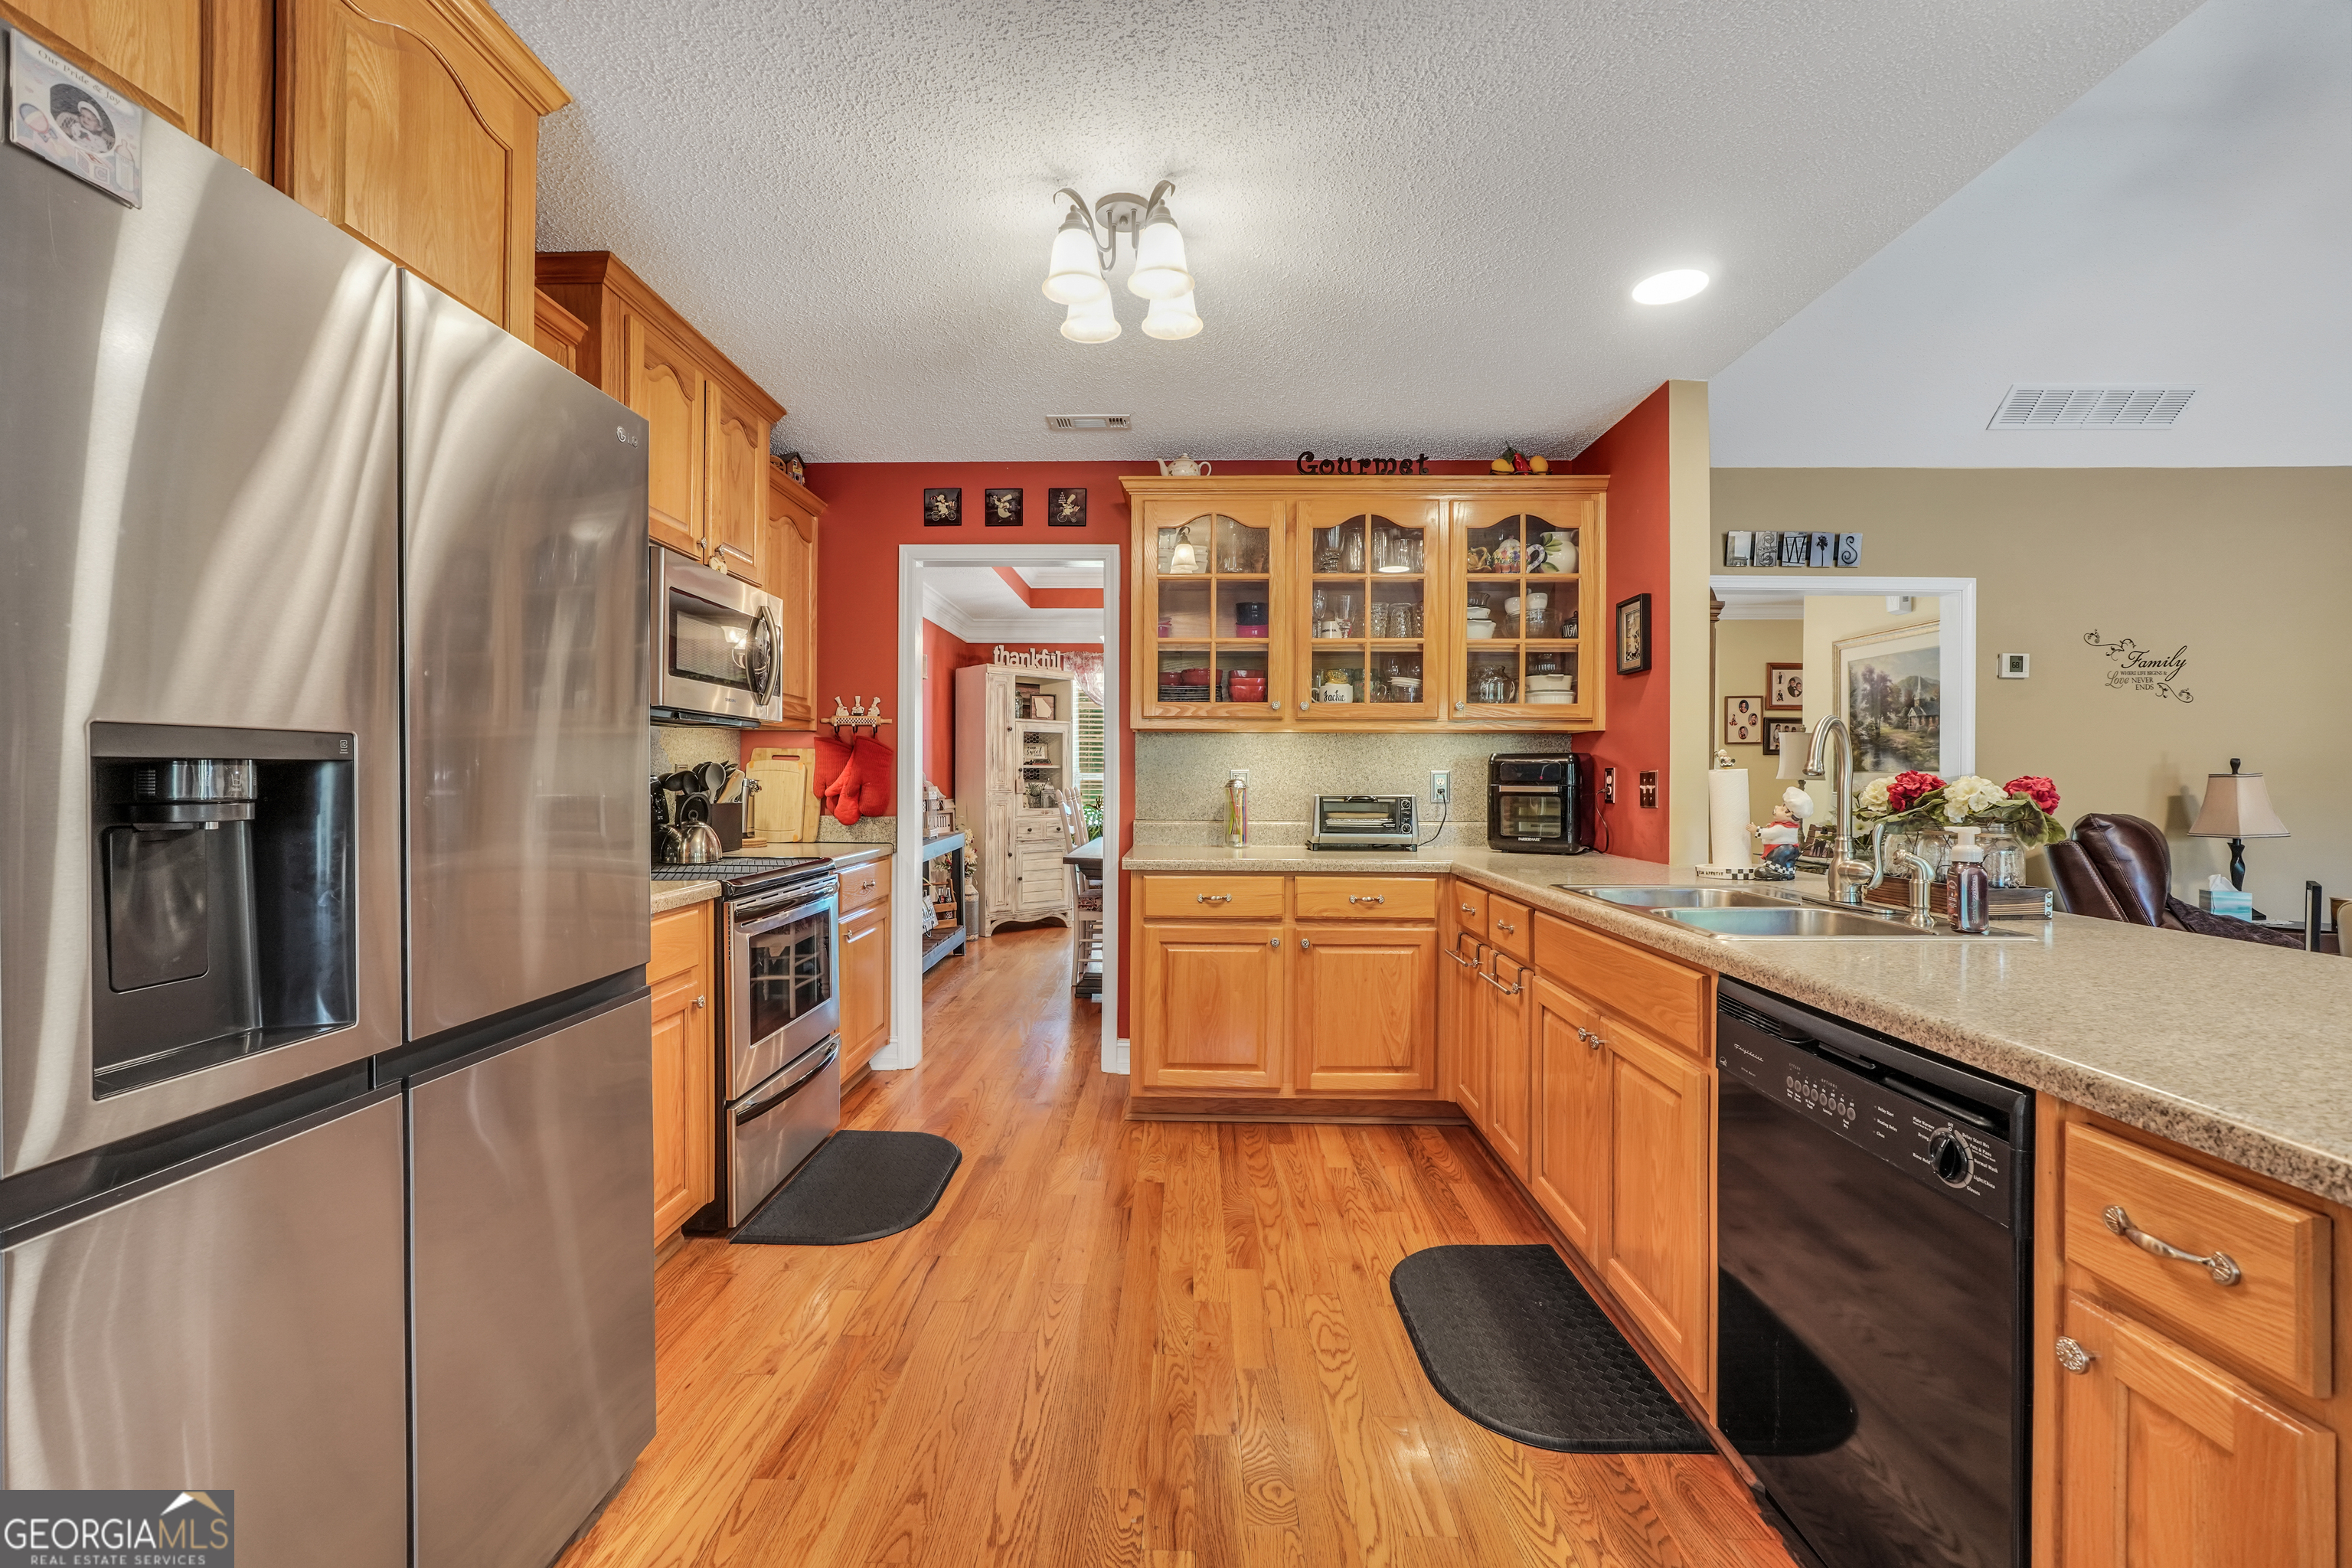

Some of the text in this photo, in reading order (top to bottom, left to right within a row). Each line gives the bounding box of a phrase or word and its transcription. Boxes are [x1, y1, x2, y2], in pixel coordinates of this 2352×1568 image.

[38, 50, 121, 106] Our Pride & Joy
[1296, 451, 1430, 475] Gourmet
[1563, 624, 1578, 638] SUGA
[993, 644, 1063, 671] thankful
[2120, 645, 2188, 682] Family
[2105, 670, 2130, 689] Love
[1323, 689, 1346, 702] Jackie
[1962, 1132, 1972, 1142] Delay
[1972, 1137, 1982, 1145] Start
[1974, 1158, 1998, 1174] Normal Wash
[1973, 1174, 1996, 1189] Light/China
[1966, 1185, 1981, 1196] Glasses
